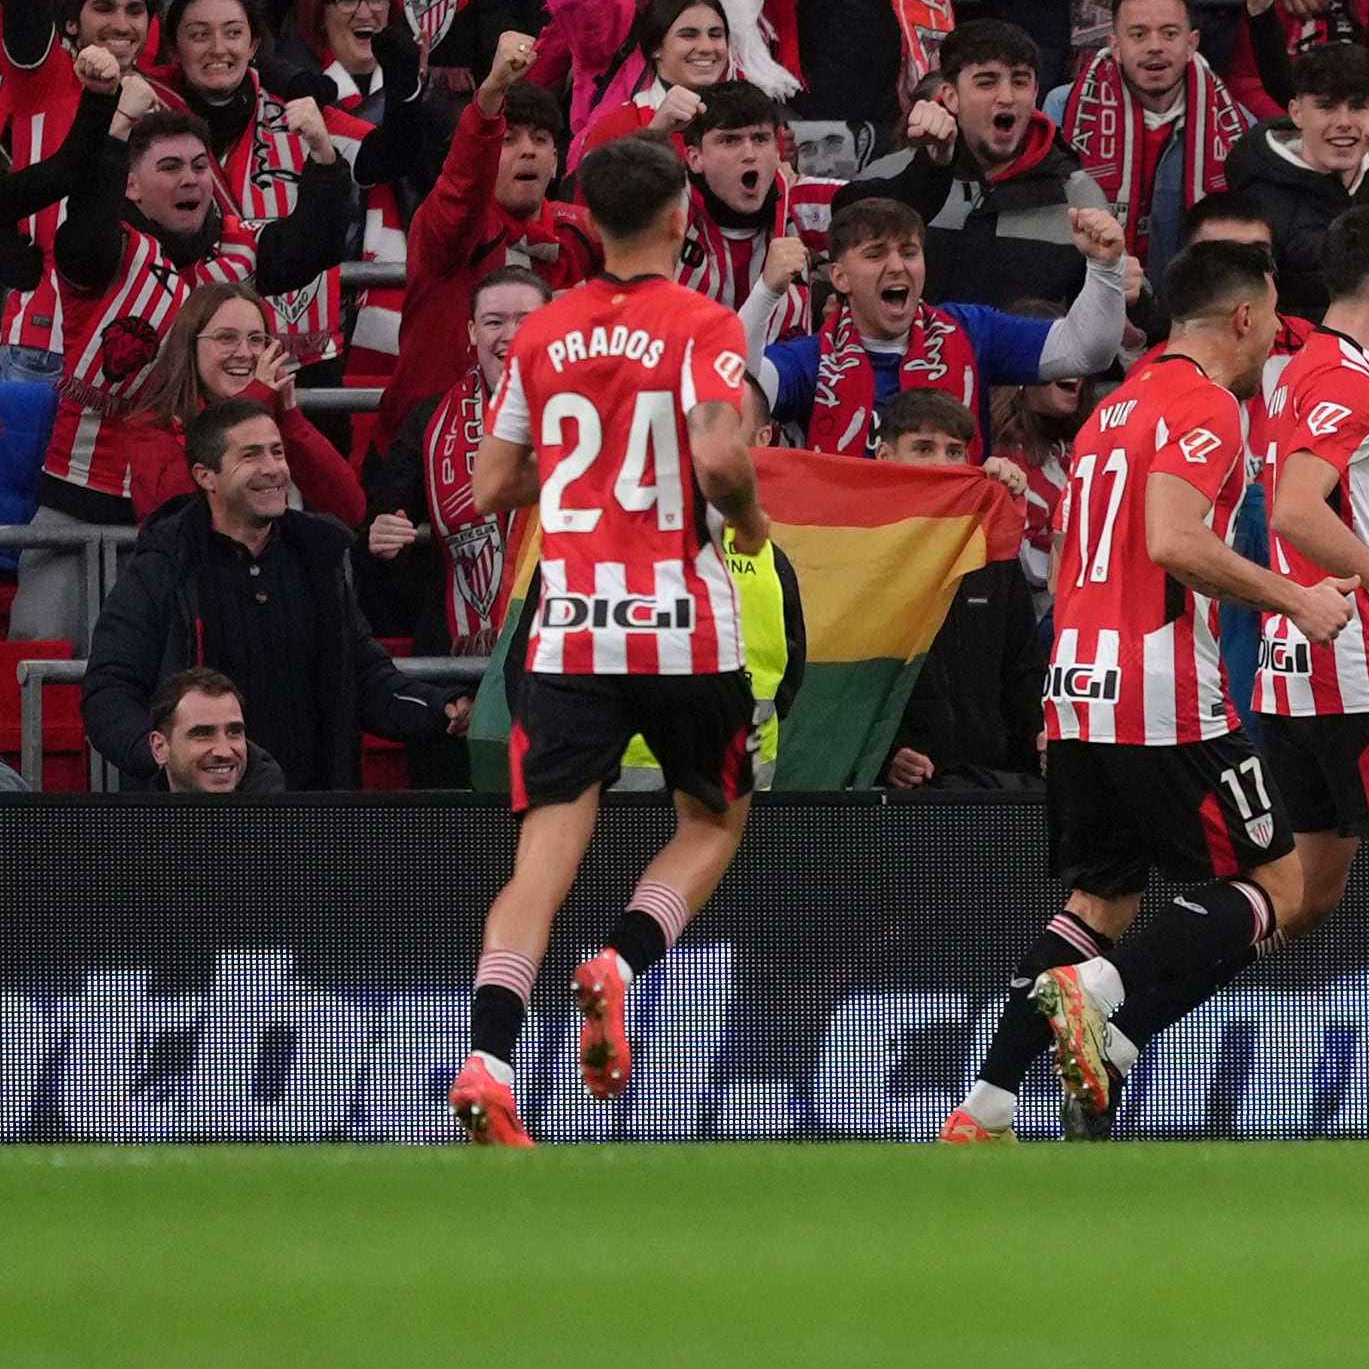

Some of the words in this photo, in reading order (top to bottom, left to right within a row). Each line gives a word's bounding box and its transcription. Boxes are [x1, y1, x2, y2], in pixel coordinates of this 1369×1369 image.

[547, 325, 666, 373] PRADOS
[539, 390, 684, 534] 24
[541, 596, 692, 630] DIGI
[1220, 754, 1273, 820] 17
